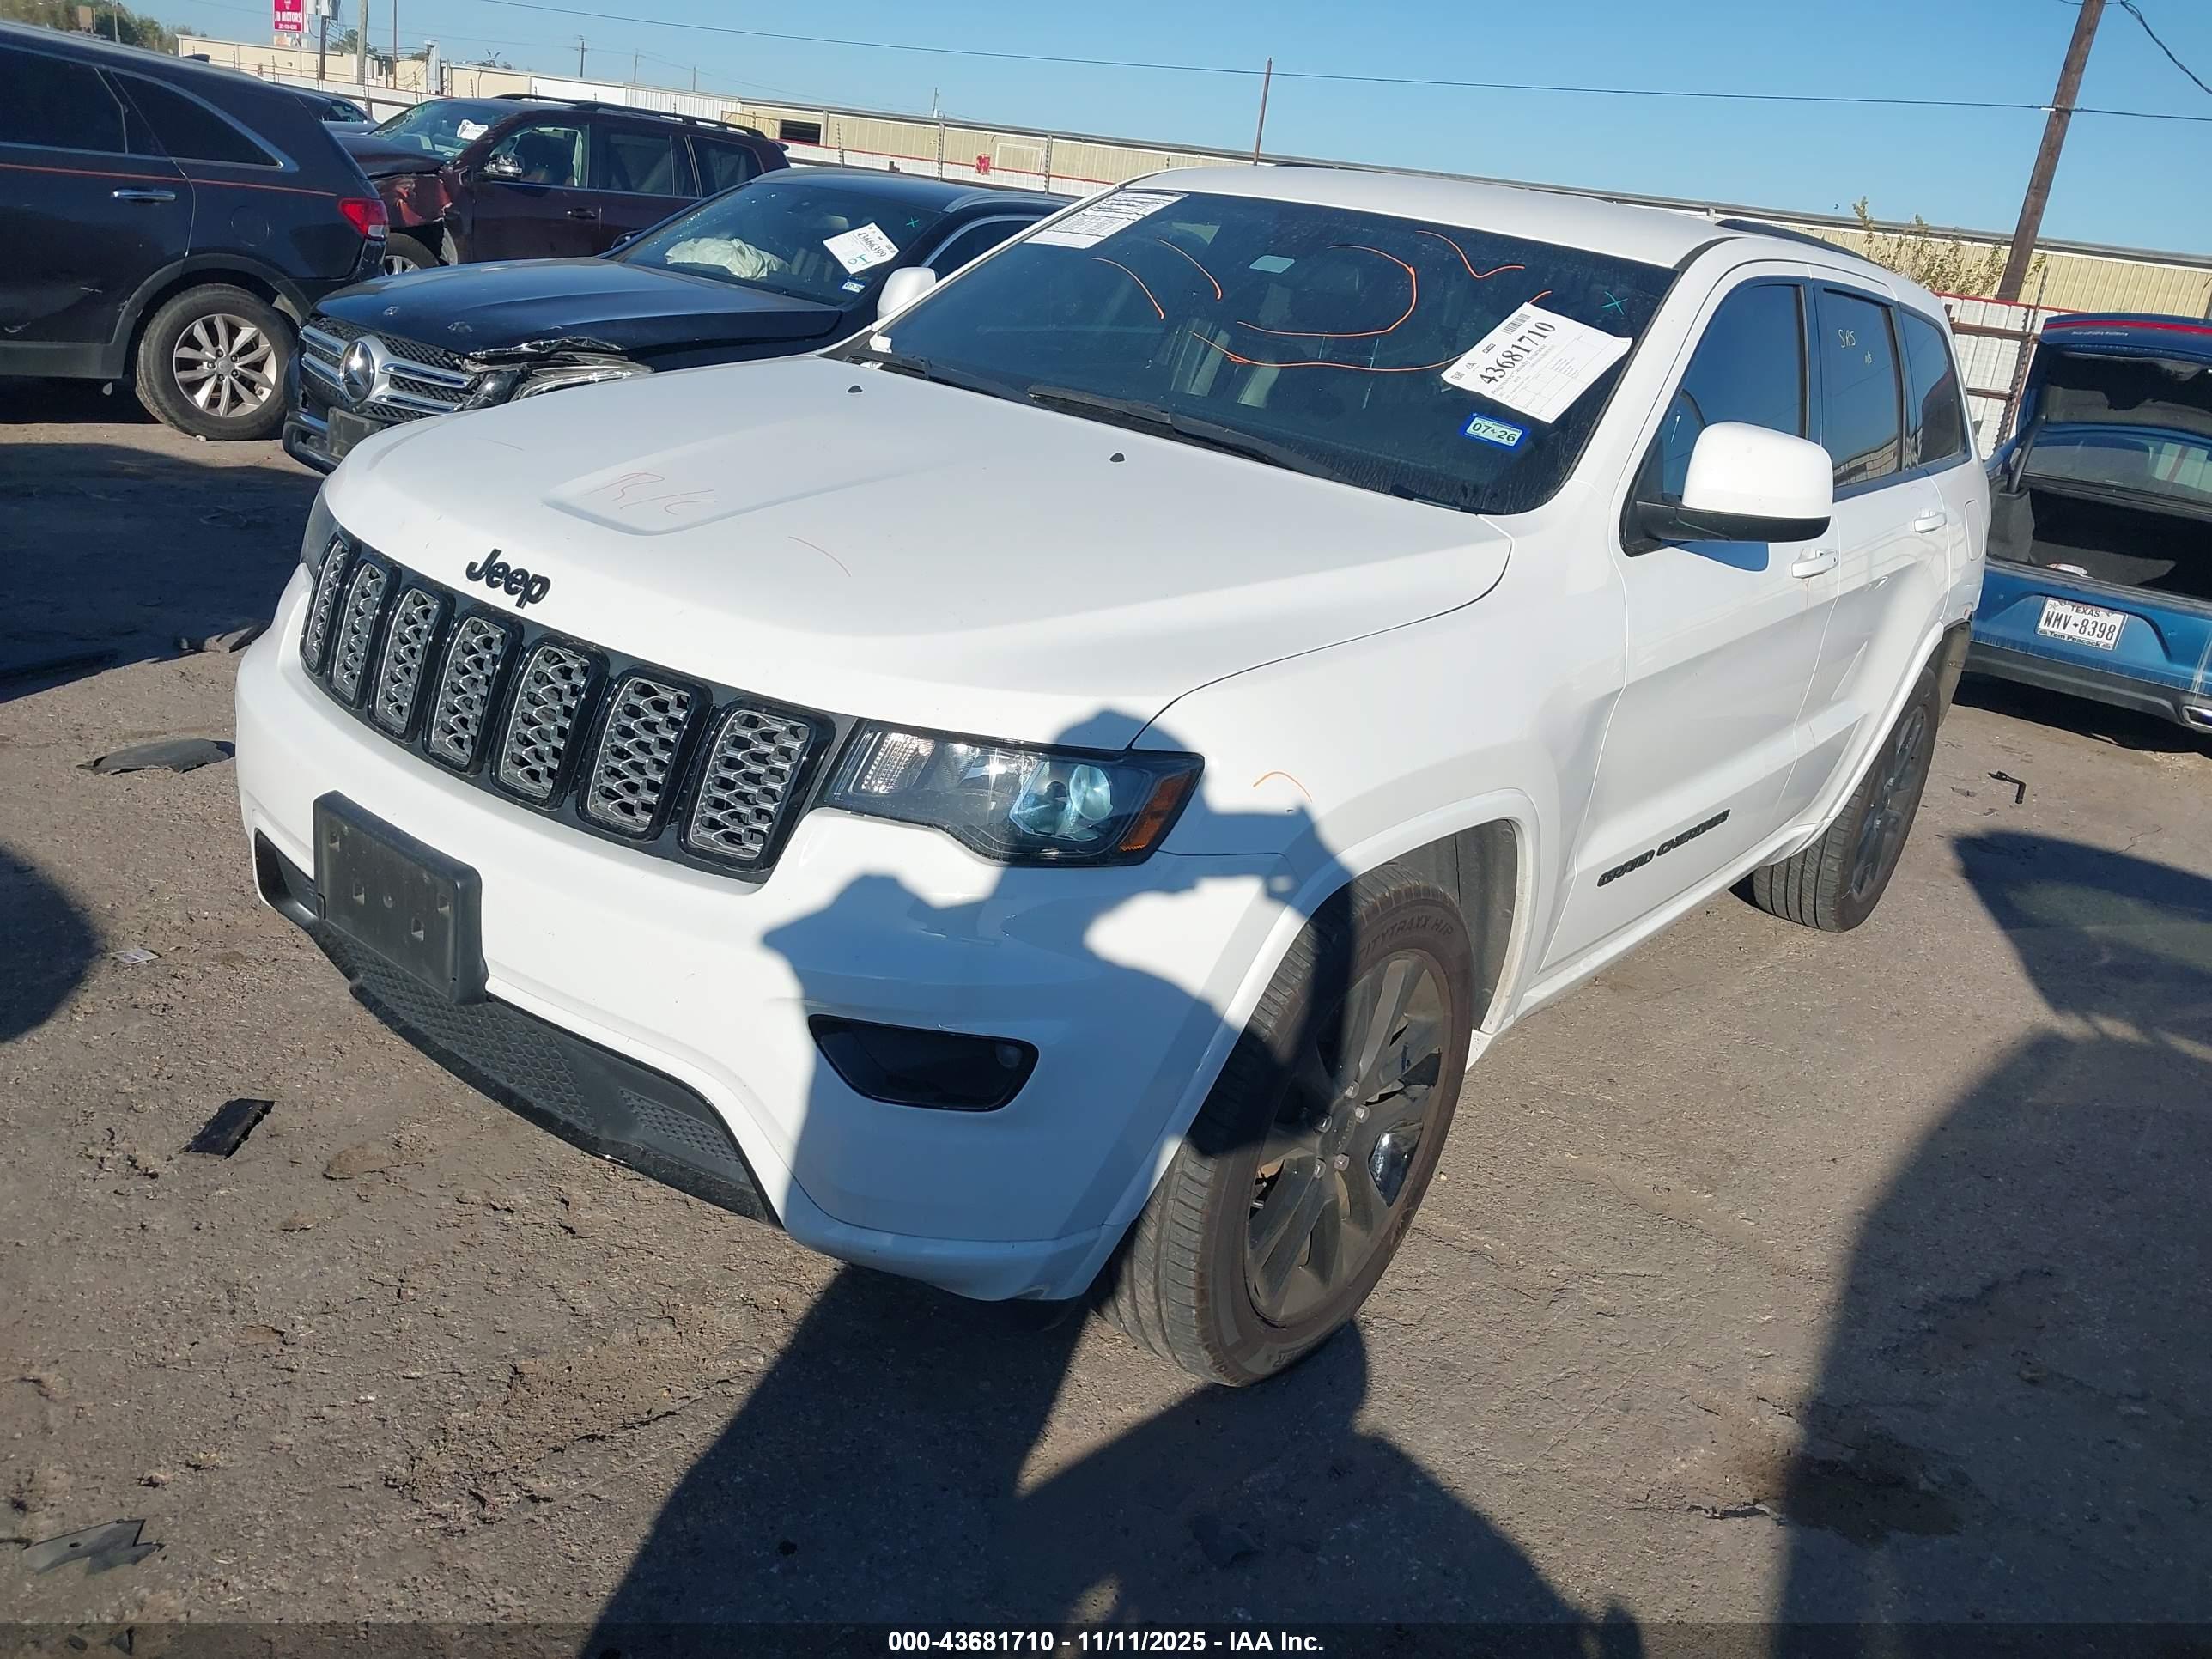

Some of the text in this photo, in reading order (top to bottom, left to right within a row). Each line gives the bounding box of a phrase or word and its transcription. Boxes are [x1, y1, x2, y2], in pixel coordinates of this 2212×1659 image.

[282, 11, 301, 23] MOTORS
[1479, 321, 1556, 385] 43681710
[1473, 422, 1517, 442] 07 26
[465, 549, 551, 610] Jeep
[2071, 605, 2100, 617] TEXAS
[2044, 611, 2117, 641] WMV 8398
[2067, 635, 2100, 647] Peacock
